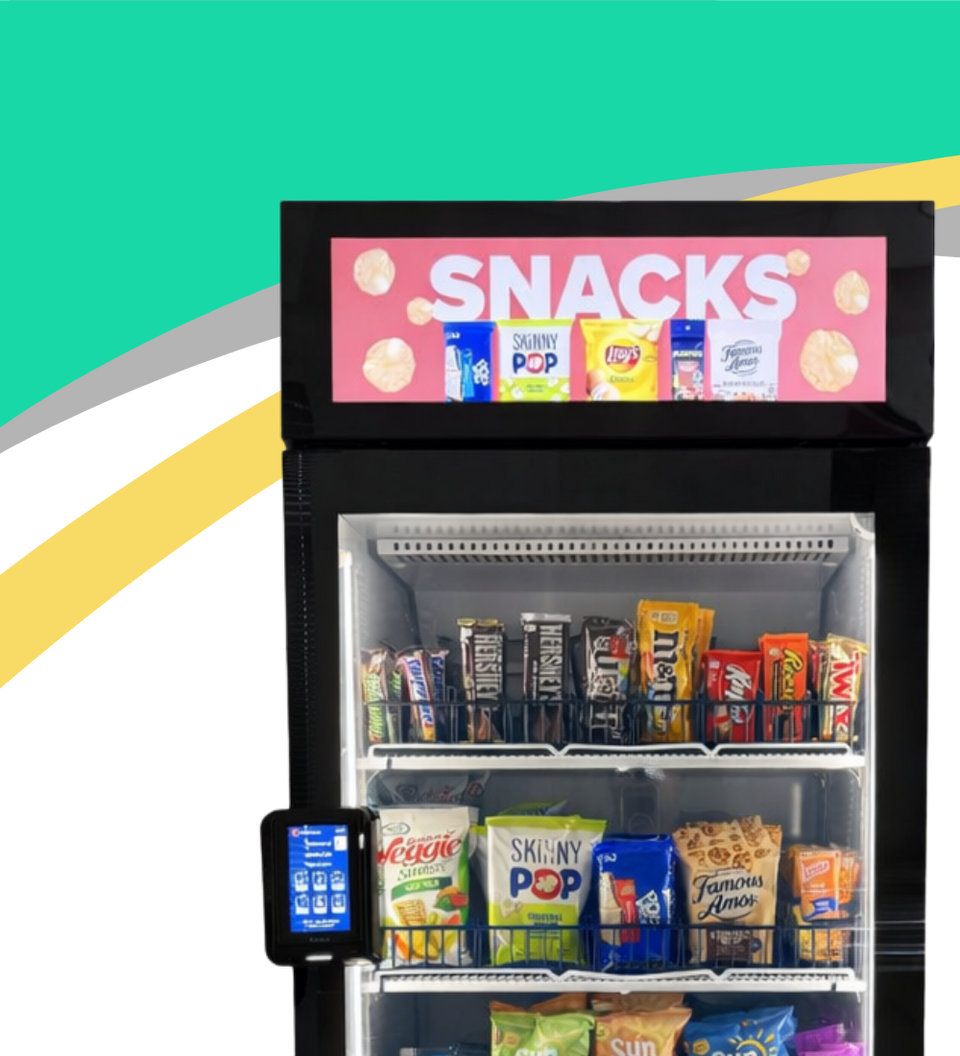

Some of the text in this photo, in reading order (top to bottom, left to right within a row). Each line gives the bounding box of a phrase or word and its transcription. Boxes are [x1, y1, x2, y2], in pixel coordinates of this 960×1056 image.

[429, 253, 797, 322] SNACKS
[512, 352, 560, 375] POP
[509, 867, 582, 900] POP
[692, 873, 764, 904] Famous
